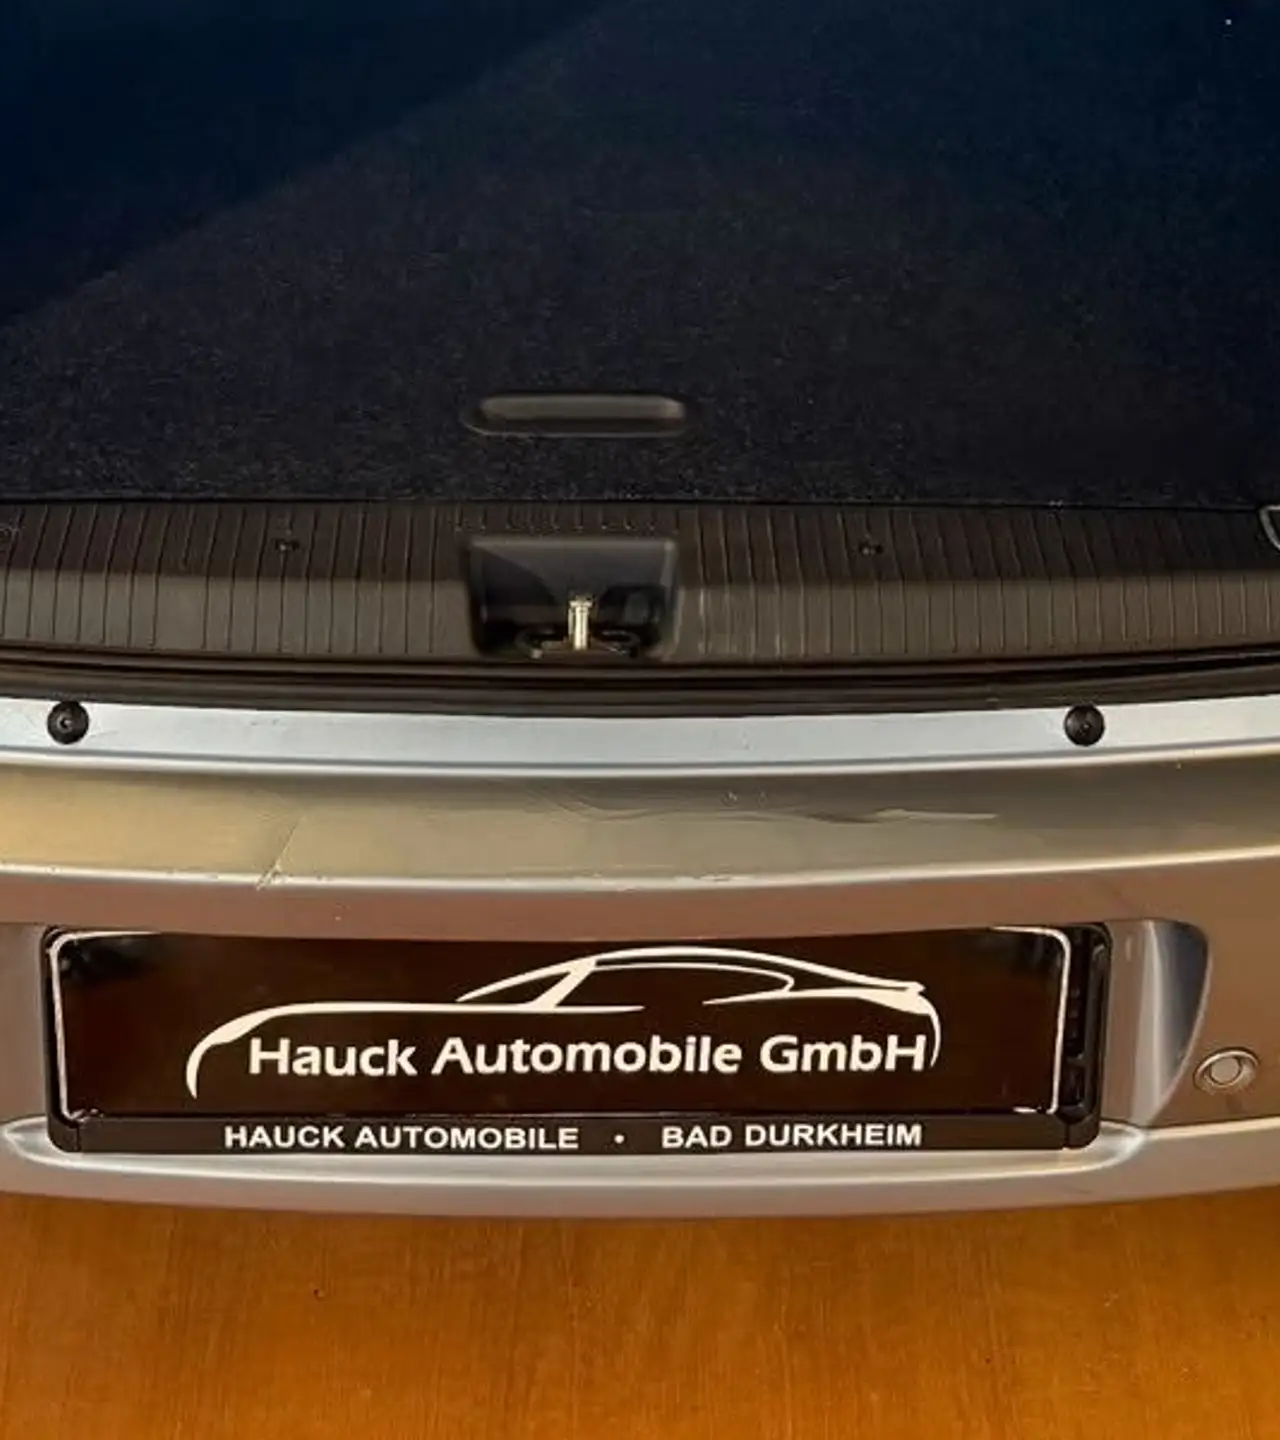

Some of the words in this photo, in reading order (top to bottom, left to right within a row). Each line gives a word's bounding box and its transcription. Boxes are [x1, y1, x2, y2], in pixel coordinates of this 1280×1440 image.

[248, 1037, 418, 1078] Hauck
[430, 1034, 744, 1076] Automobile
[758, 1034, 928, 1074] GmbH
[223, 1124, 346, 1150] HAUCK
[353, 1124, 580, 1151] AUTOMOBILE
[660, 1124, 734, 1150] BAD
[744, 1122, 923, 1148] DURKHEIM
